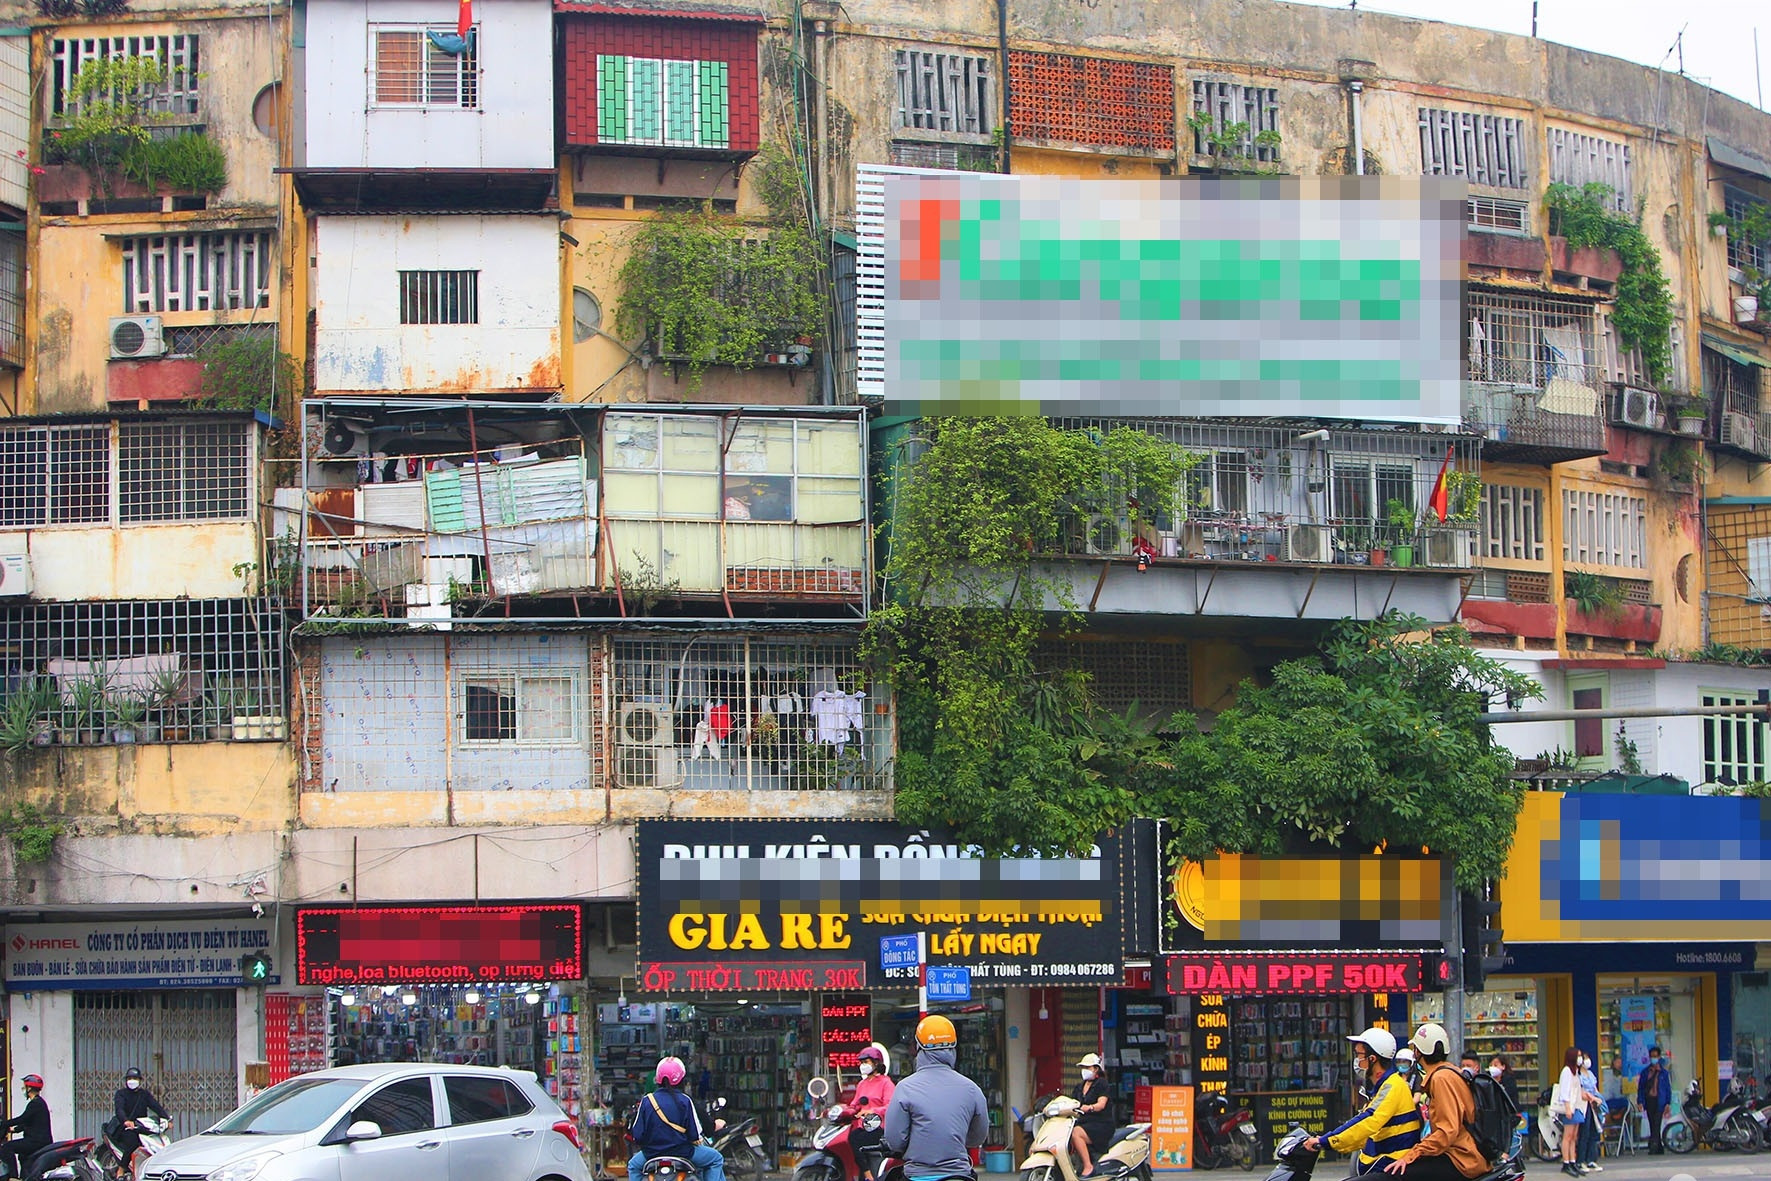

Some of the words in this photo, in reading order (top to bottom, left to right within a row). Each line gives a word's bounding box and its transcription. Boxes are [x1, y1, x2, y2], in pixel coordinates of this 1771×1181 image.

[29, 938, 80, 949] HANEL
[87, 930, 111, 951] CÔNG
[114, 933, 124, 951] TY
[166, 932, 188, 954] DỊCH
[191, 932, 201, 953] VỤ
[204, 927, 225, 952] ĐIỆN
[240, 930, 269, 947] HANEL
[895, 939, 908, 947] PHỐ
[931, 927, 975, 956] LẤY
[980, 933, 1042, 956] NGAY
[903, 948, 916, 962] TÁC
[644, 964, 677, 989] ỐP
[686, 964, 742, 987] THỜI
[755, 969, 813, 988] TRANG
[825, 969, 860, 988] 30K
[967, 961, 991, 976] HẤT
[994, 962, 1021, 976] TÙNG
[1030, 964, 1048, 976] ĐT:
[1268, 964, 1333, 988] PPF
[1343, 964, 1408, 988] 50K
[1197, 1010, 1227, 1027] CHỮA
[1206, 1033, 1221, 1049] ÉP
[1200, 1054, 1227, 1071] KÍNH
